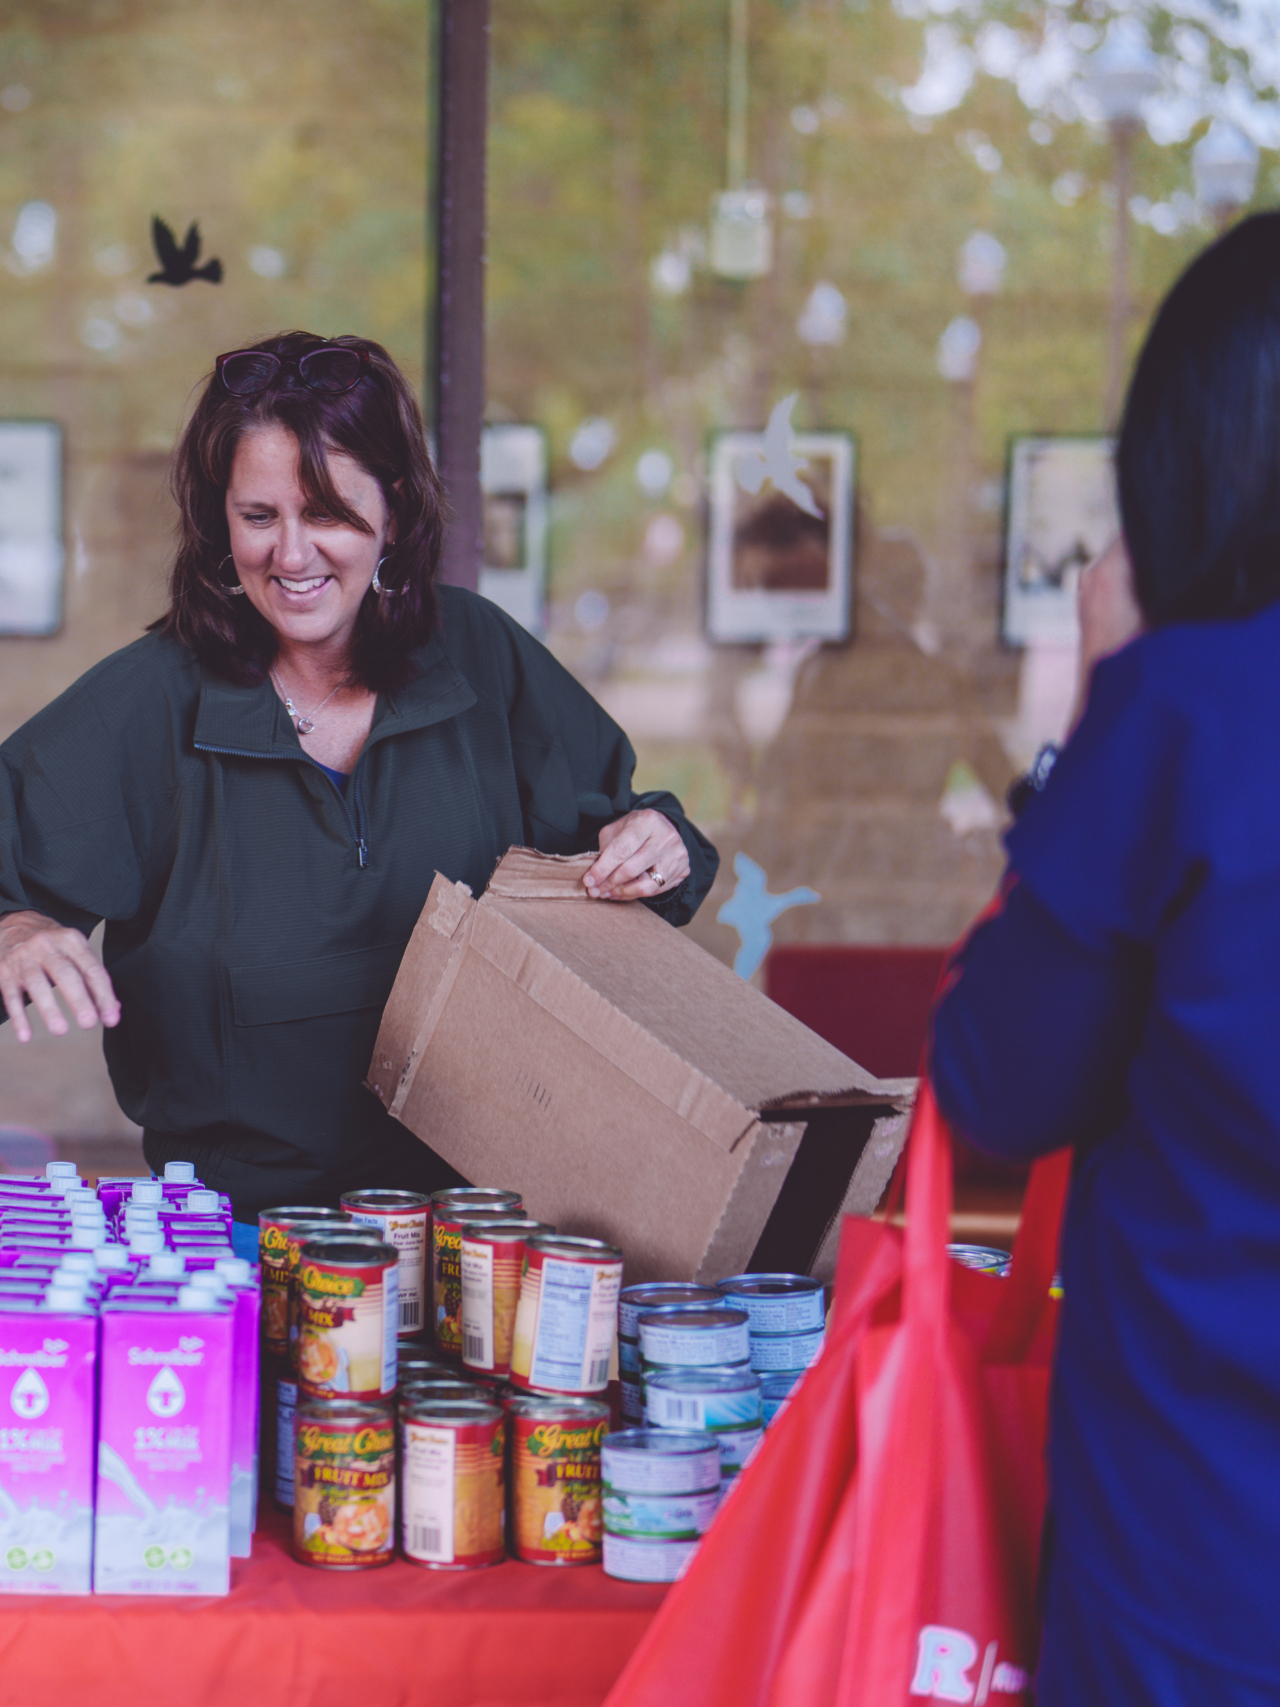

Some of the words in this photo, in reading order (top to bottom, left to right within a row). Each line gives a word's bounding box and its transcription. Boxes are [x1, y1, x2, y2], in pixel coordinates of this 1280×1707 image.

[393, 1232, 410, 1240] Fruit
[410, 1231, 420, 1239] Mix
[433, 1225, 462, 1252] Grea
[302, 1265, 355, 1296] Choice
[442, 1262, 462, 1279] FRU
[308, 1309, 335, 1327] MIX
[133, 1426, 164, 1450] 1%
[299, 1425, 353, 1457] Great
[534, 1423, 594, 1457] Great
[314, 1466, 360, 1486] FRUIT
[362, 1472, 390, 1488] MIX
[556, 1464, 599, 1480] FRUIT
